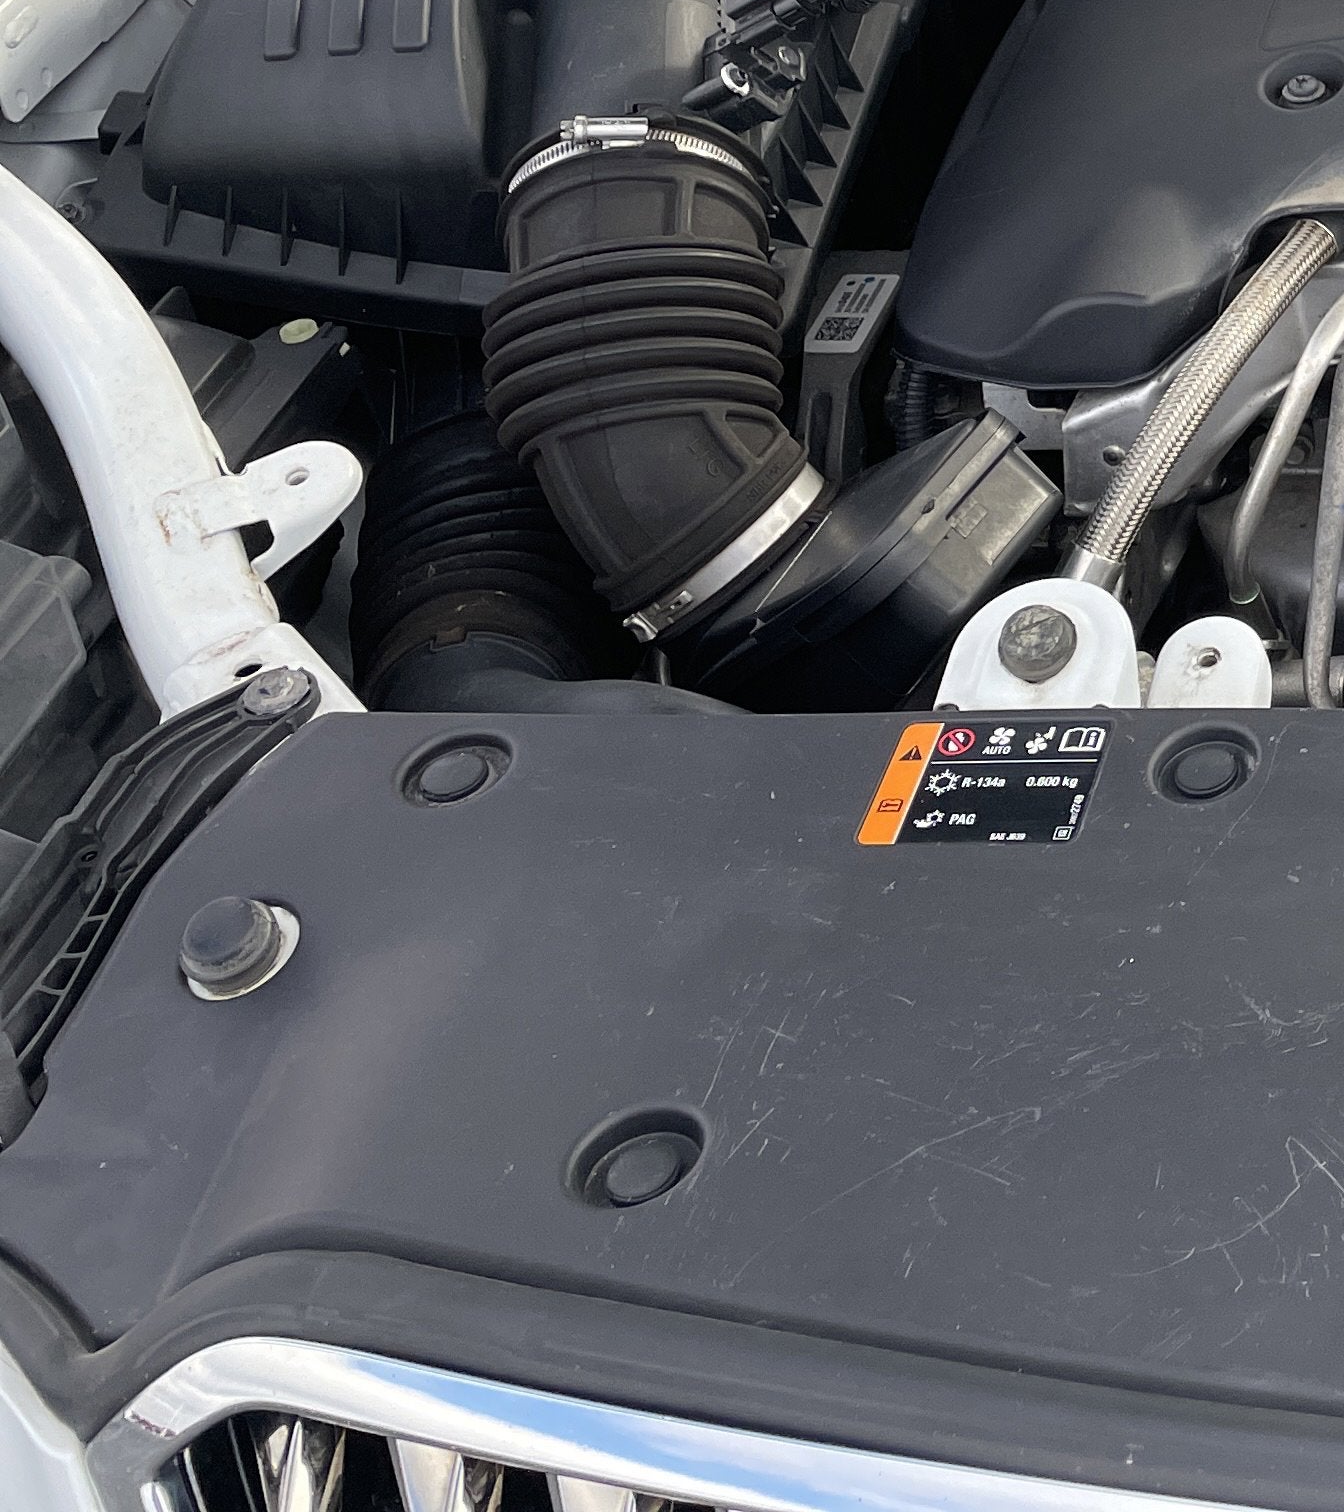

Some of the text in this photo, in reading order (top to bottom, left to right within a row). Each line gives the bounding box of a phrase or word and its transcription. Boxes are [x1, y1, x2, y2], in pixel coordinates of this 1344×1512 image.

[982, 746, 1011, 755] AUTO
[961, 776, 1006, 788] R-134a
[1062, 776, 1079, 788] kg
[949, 813, 976, 826] PAG
